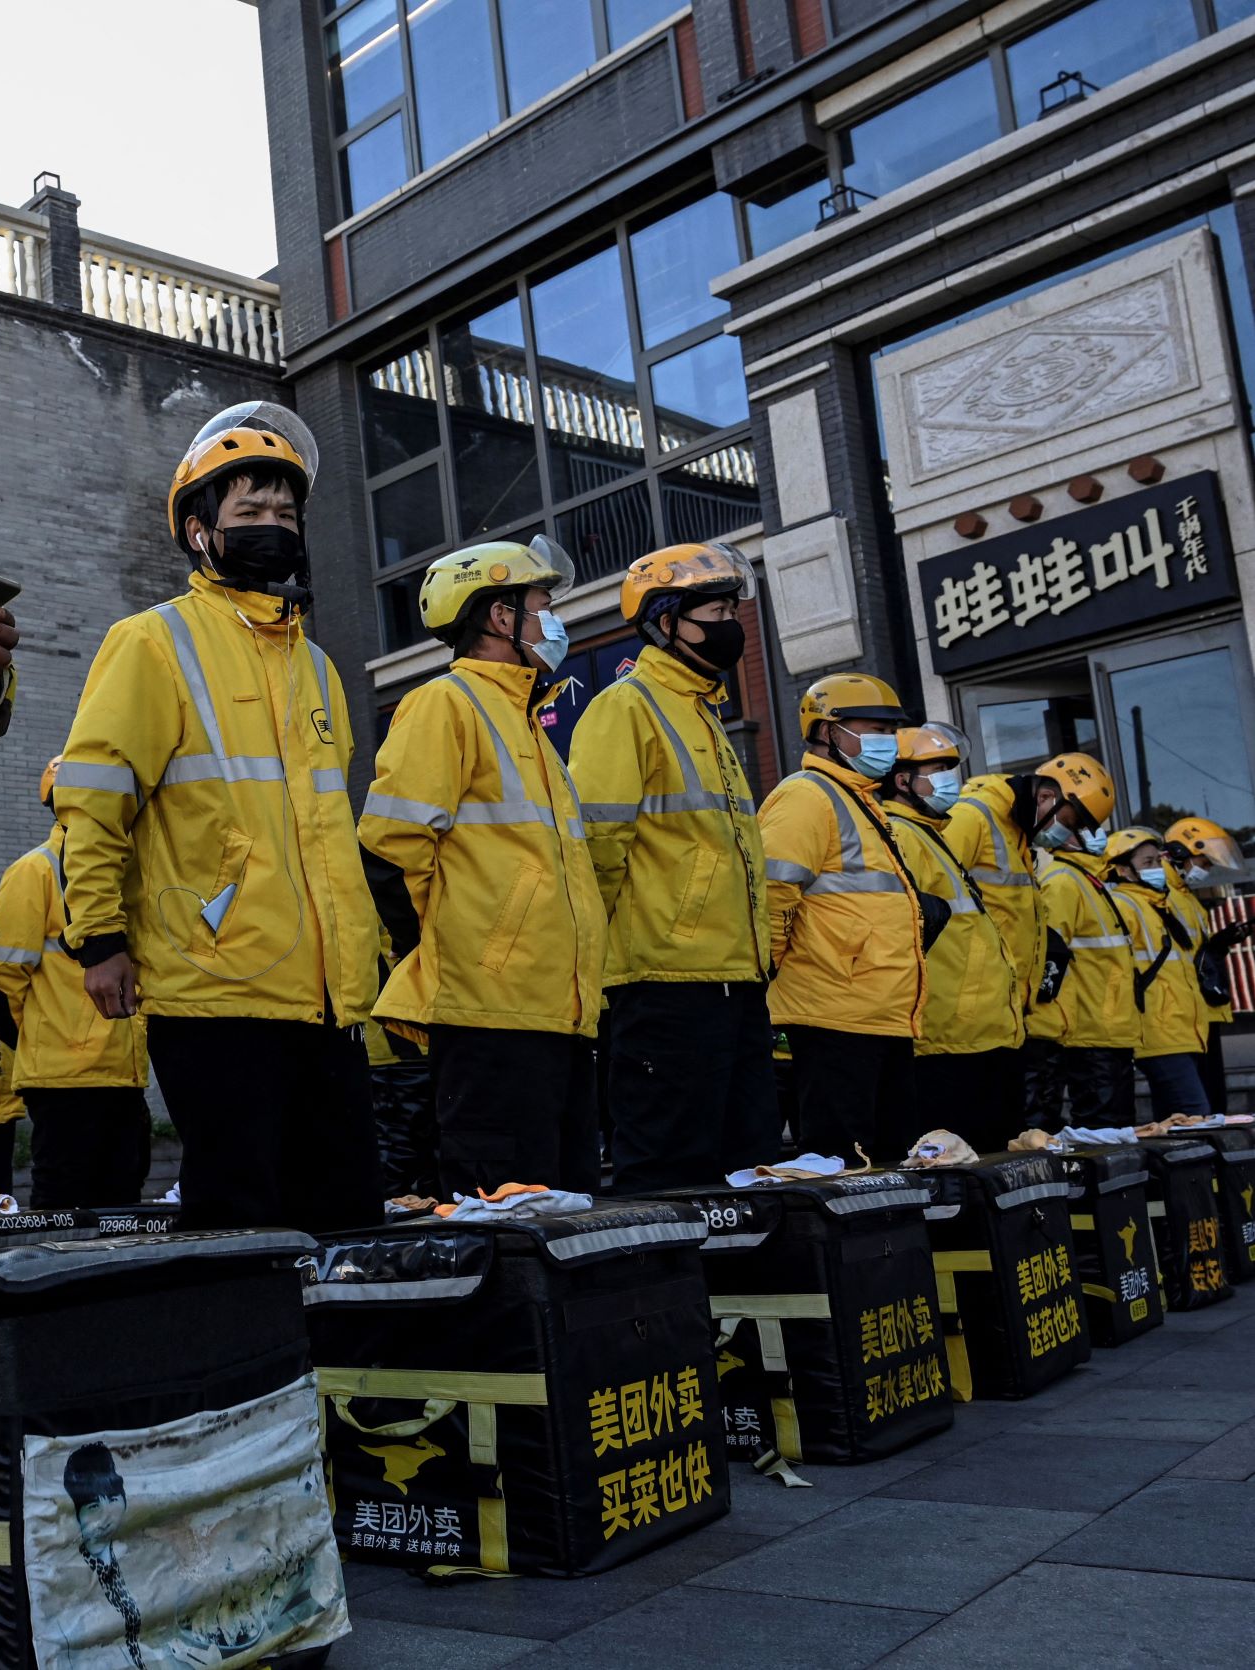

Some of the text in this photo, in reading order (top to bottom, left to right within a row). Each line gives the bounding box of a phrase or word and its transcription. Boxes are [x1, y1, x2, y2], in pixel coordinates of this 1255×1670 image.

[1174, 495, 1208, 582] 干锅年代
[934, 508, 1174, 649] 蛙蛙叫
[1016, 1243, 1072, 1306] 美团外卖
[1120, 1267, 1150, 1303] 美团外卖
[860, 1294, 934, 1364] 美团外卖
[1027, 1294, 1081, 1360] 送药也快
[588, 1365, 704, 1458] 美团外卖
[866, 1353, 945, 1424] 买水果也快
[352, 1500, 463, 1540] 美团外卖
[598, 1440, 713, 1541] 买菜也快
[351, 1532, 461, 1558] 美团外卖 送啥都快
